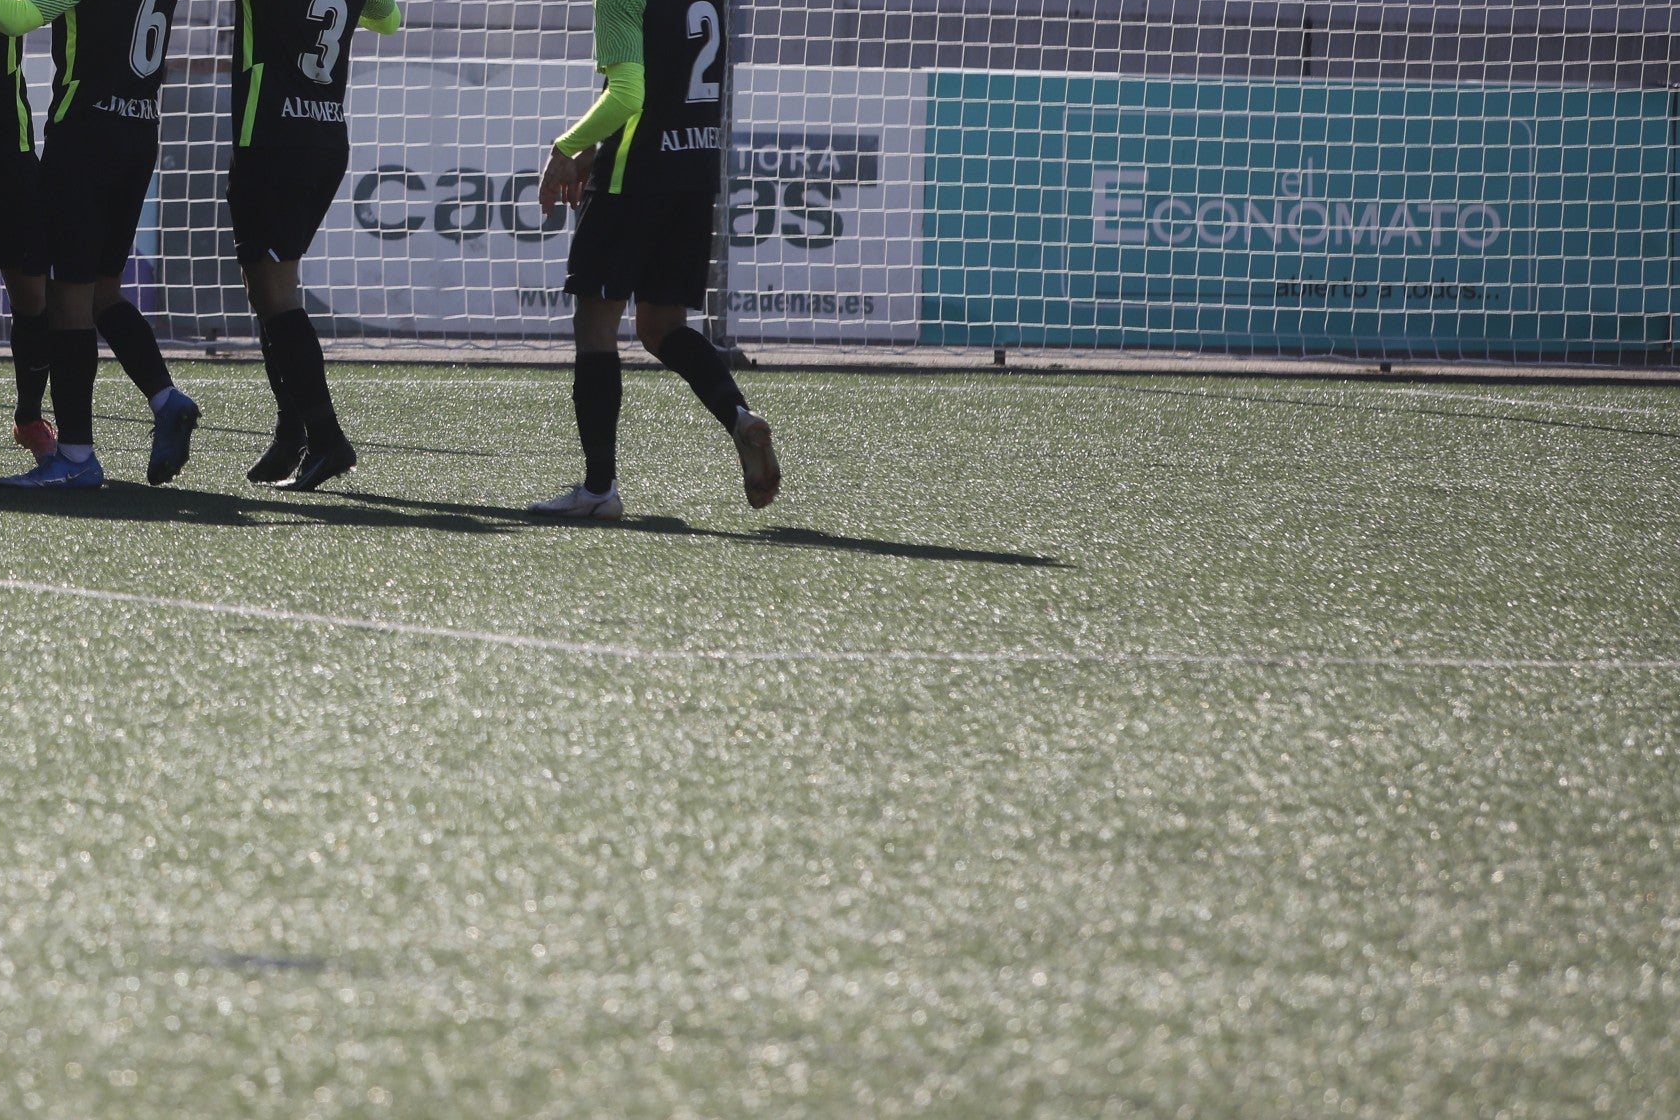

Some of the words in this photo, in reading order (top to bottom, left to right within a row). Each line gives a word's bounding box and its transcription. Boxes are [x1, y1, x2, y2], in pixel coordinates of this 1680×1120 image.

[684, 0, 721, 104] 2
[1281, 157, 1314, 198] el
[1275, 275, 1367, 300] abierto
[1376, 282, 1392, 300] a
